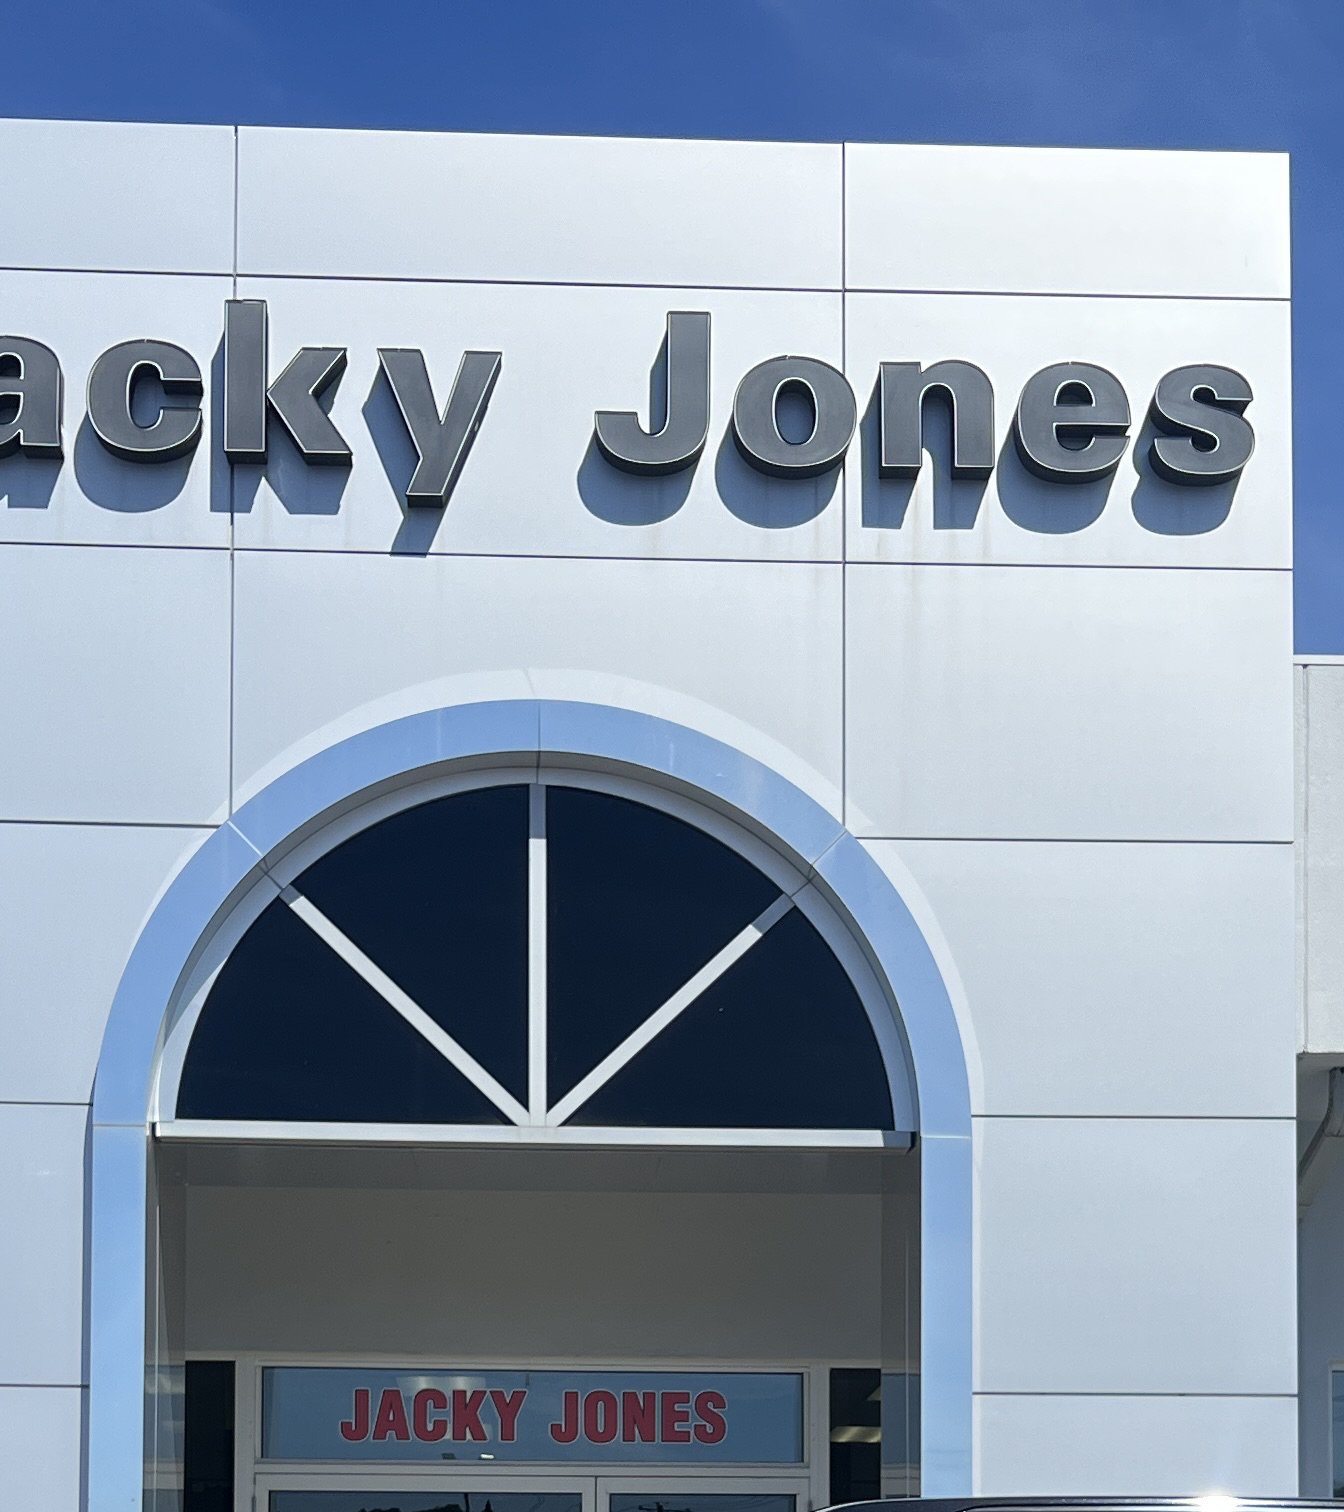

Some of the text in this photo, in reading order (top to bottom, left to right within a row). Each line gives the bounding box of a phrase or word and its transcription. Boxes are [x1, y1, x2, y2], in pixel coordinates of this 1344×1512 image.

[594, 309, 1256, 485] Jones
[339, 1387, 729, 1444] JACKY JONES
